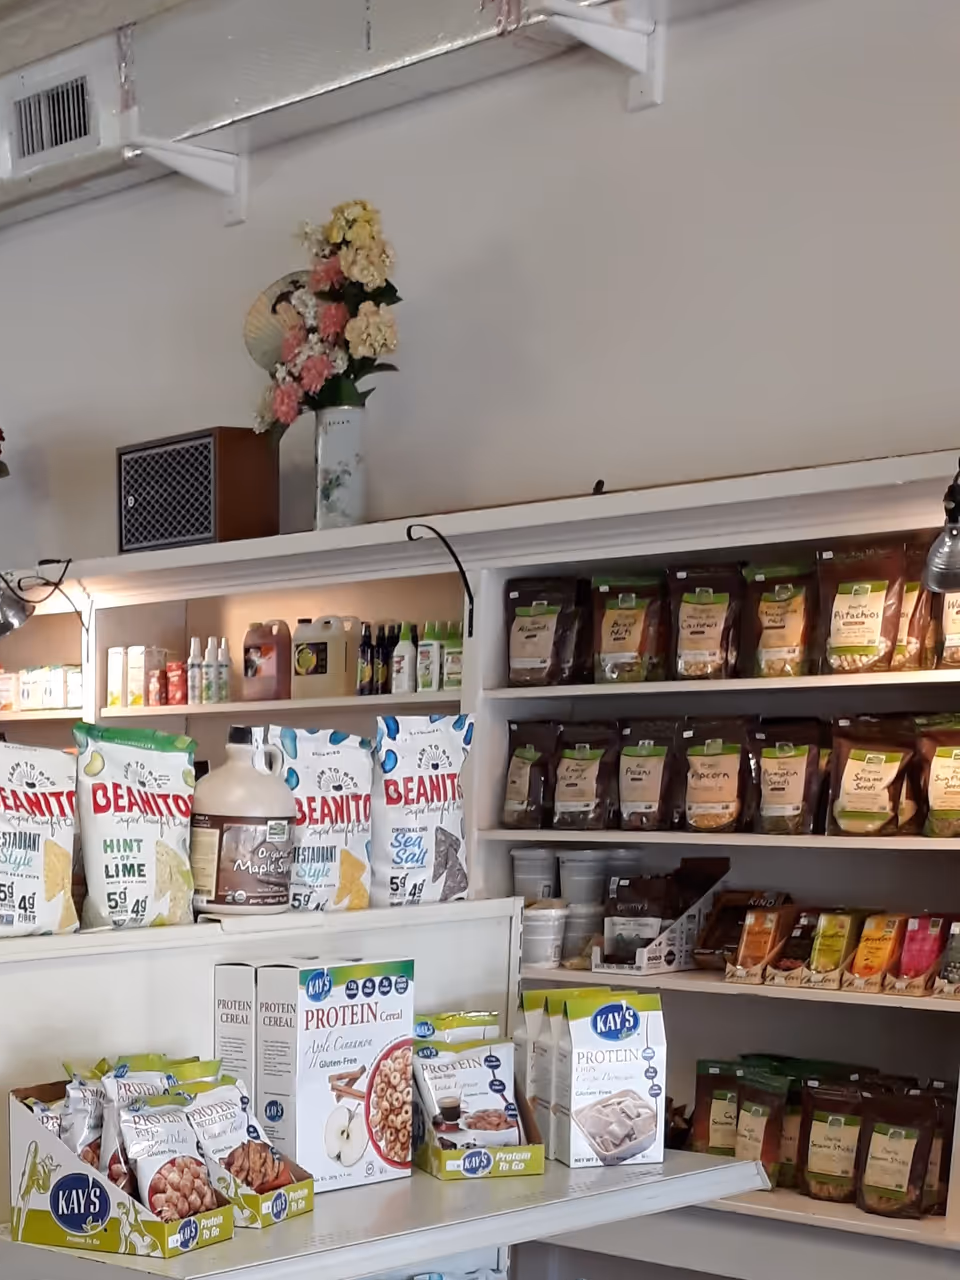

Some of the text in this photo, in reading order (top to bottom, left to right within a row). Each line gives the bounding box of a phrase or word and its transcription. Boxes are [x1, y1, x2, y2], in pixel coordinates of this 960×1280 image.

[102, 838, 143, 854] HINT
[390, 832, 423, 850] Sea
[392, 848, 428, 866] Salt
[104, 863, 146, 880] LIME
[233, 859, 276, 876] Maple
[296, 863, 331, 883] Style
[390, 873, 409, 892] 5g
[409, 879, 426, 898] 4g
[18, 892, 36, 914] 4g
[107, 886, 128, 908] 5g
[131, 893, 148, 917] 4g
[748, 897, 775, 908] KIND
[308, 972, 330, 997] KAY'S
[217, 999, 252, 1012] PROTEIN
[259, 1001, 296, 1014] PROTEIN
[220, 1012, 251, 1025] CEREAL
[262, 1015, 295, 1028] CEREAL
[305, 1001, 403, 1031] PROTEIN Cereal
[596, 1001, 634, 1033] KAY'S
[319, 1057, 358, 1069] Gluten-Free
[576, 1048, 639, 1065] PROTEIN
[421, 1056, 483, 1075] PROTEIN
[464, 1152, 488, 1169] KAY'S
[496, 1151, 531, 1161] Protein
[499, 1160, 525, 1170] To Go
[58, 1180, 100, 1215] KAY'S
[201, 1215, 223, 1228] Protein
[202, 1227, 220, 1239] To Go
